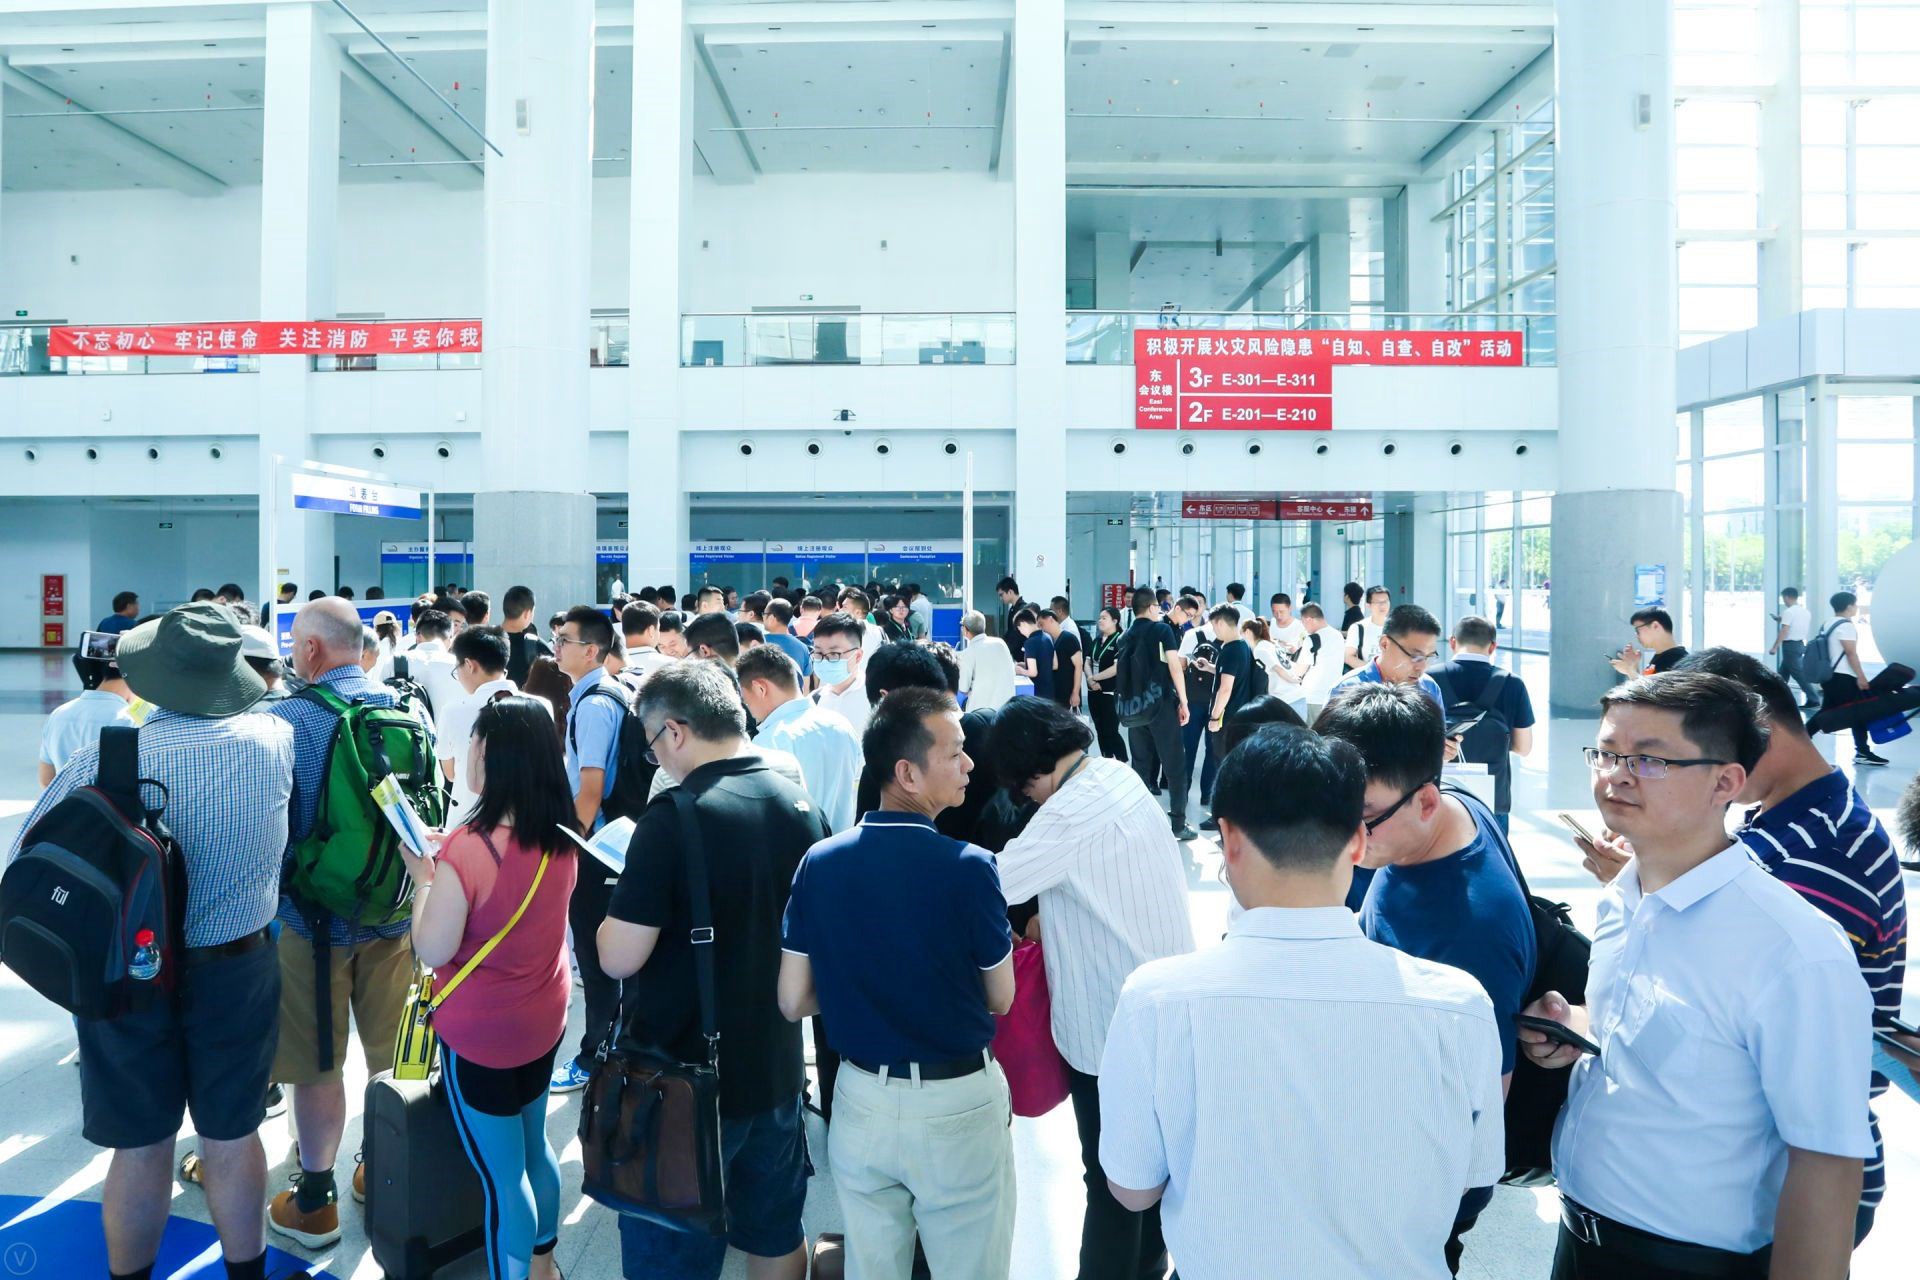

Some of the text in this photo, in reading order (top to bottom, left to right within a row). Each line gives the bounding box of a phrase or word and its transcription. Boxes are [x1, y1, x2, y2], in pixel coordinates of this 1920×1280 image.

[72, 327, 479, 351] 不忘初心 牢记使命 关注消防 平安你我
[1149, 369, 1163, 383] 东
[1188, 366, 1213, 388] 3F
[1138, 384, 1173, 397] 会议楼
[1188, 401, 1213, 423] 2F
